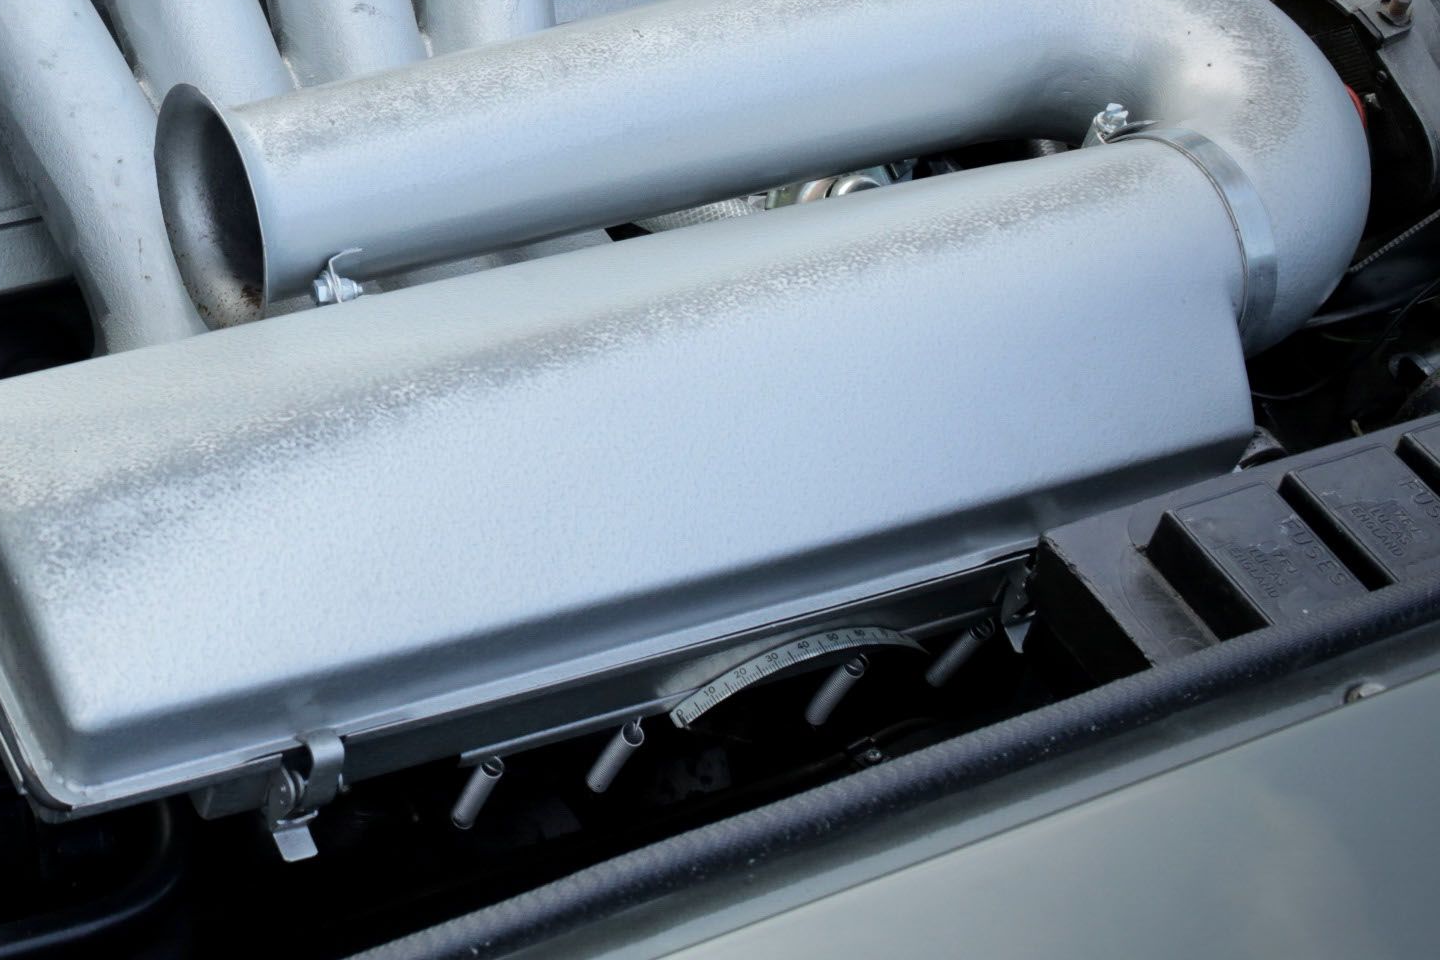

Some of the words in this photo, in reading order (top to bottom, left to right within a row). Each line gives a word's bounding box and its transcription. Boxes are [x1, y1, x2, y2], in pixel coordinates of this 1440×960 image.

[1281, 518, 1348, 587] FUSES
[1351, 504, 1405, 557] ENGLAND
[1371, 507, 1409, 546] LUCAS
[704, 686, 716, 697] 10
[734, 667, 747, 679] 20
[765, 652, 779, 663] 30
[797, 641, 810, 650] 40
[826, 632, 839, 641] 50
